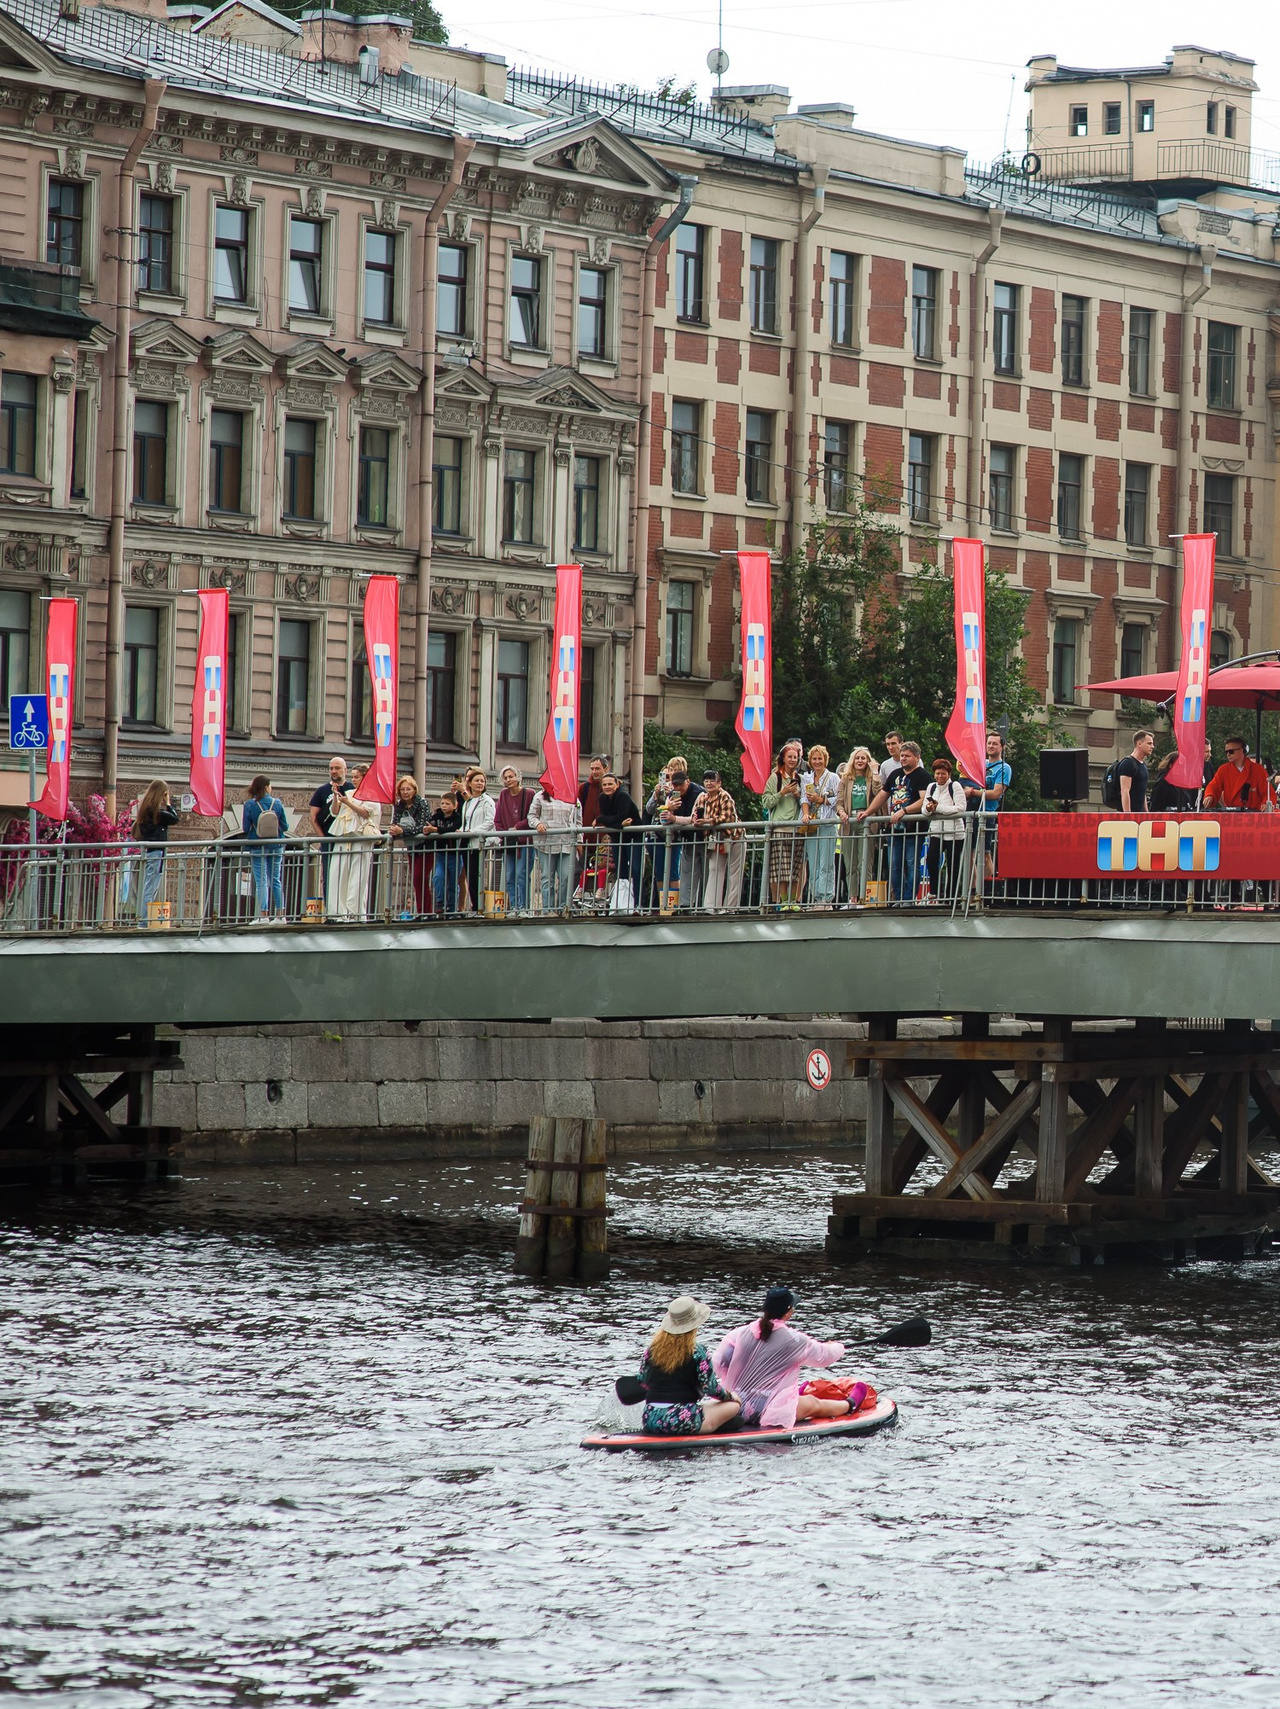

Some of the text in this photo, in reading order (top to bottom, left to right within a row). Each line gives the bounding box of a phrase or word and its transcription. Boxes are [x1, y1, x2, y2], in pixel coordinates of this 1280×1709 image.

[50, 663, 69, 763] ТНТ
[200, 655, 222, 758] ТНТ
[372, 643, 392, 747] ТНТ
[554, 635, 575, 742] ТНТ
[743, 622, 766, 732] ТНТ
[962, 612, 984, 724] ТНТ
[1182, 609, 1206, 722] ТНТ
[1097, 820, 1221, 871] ТНТ
